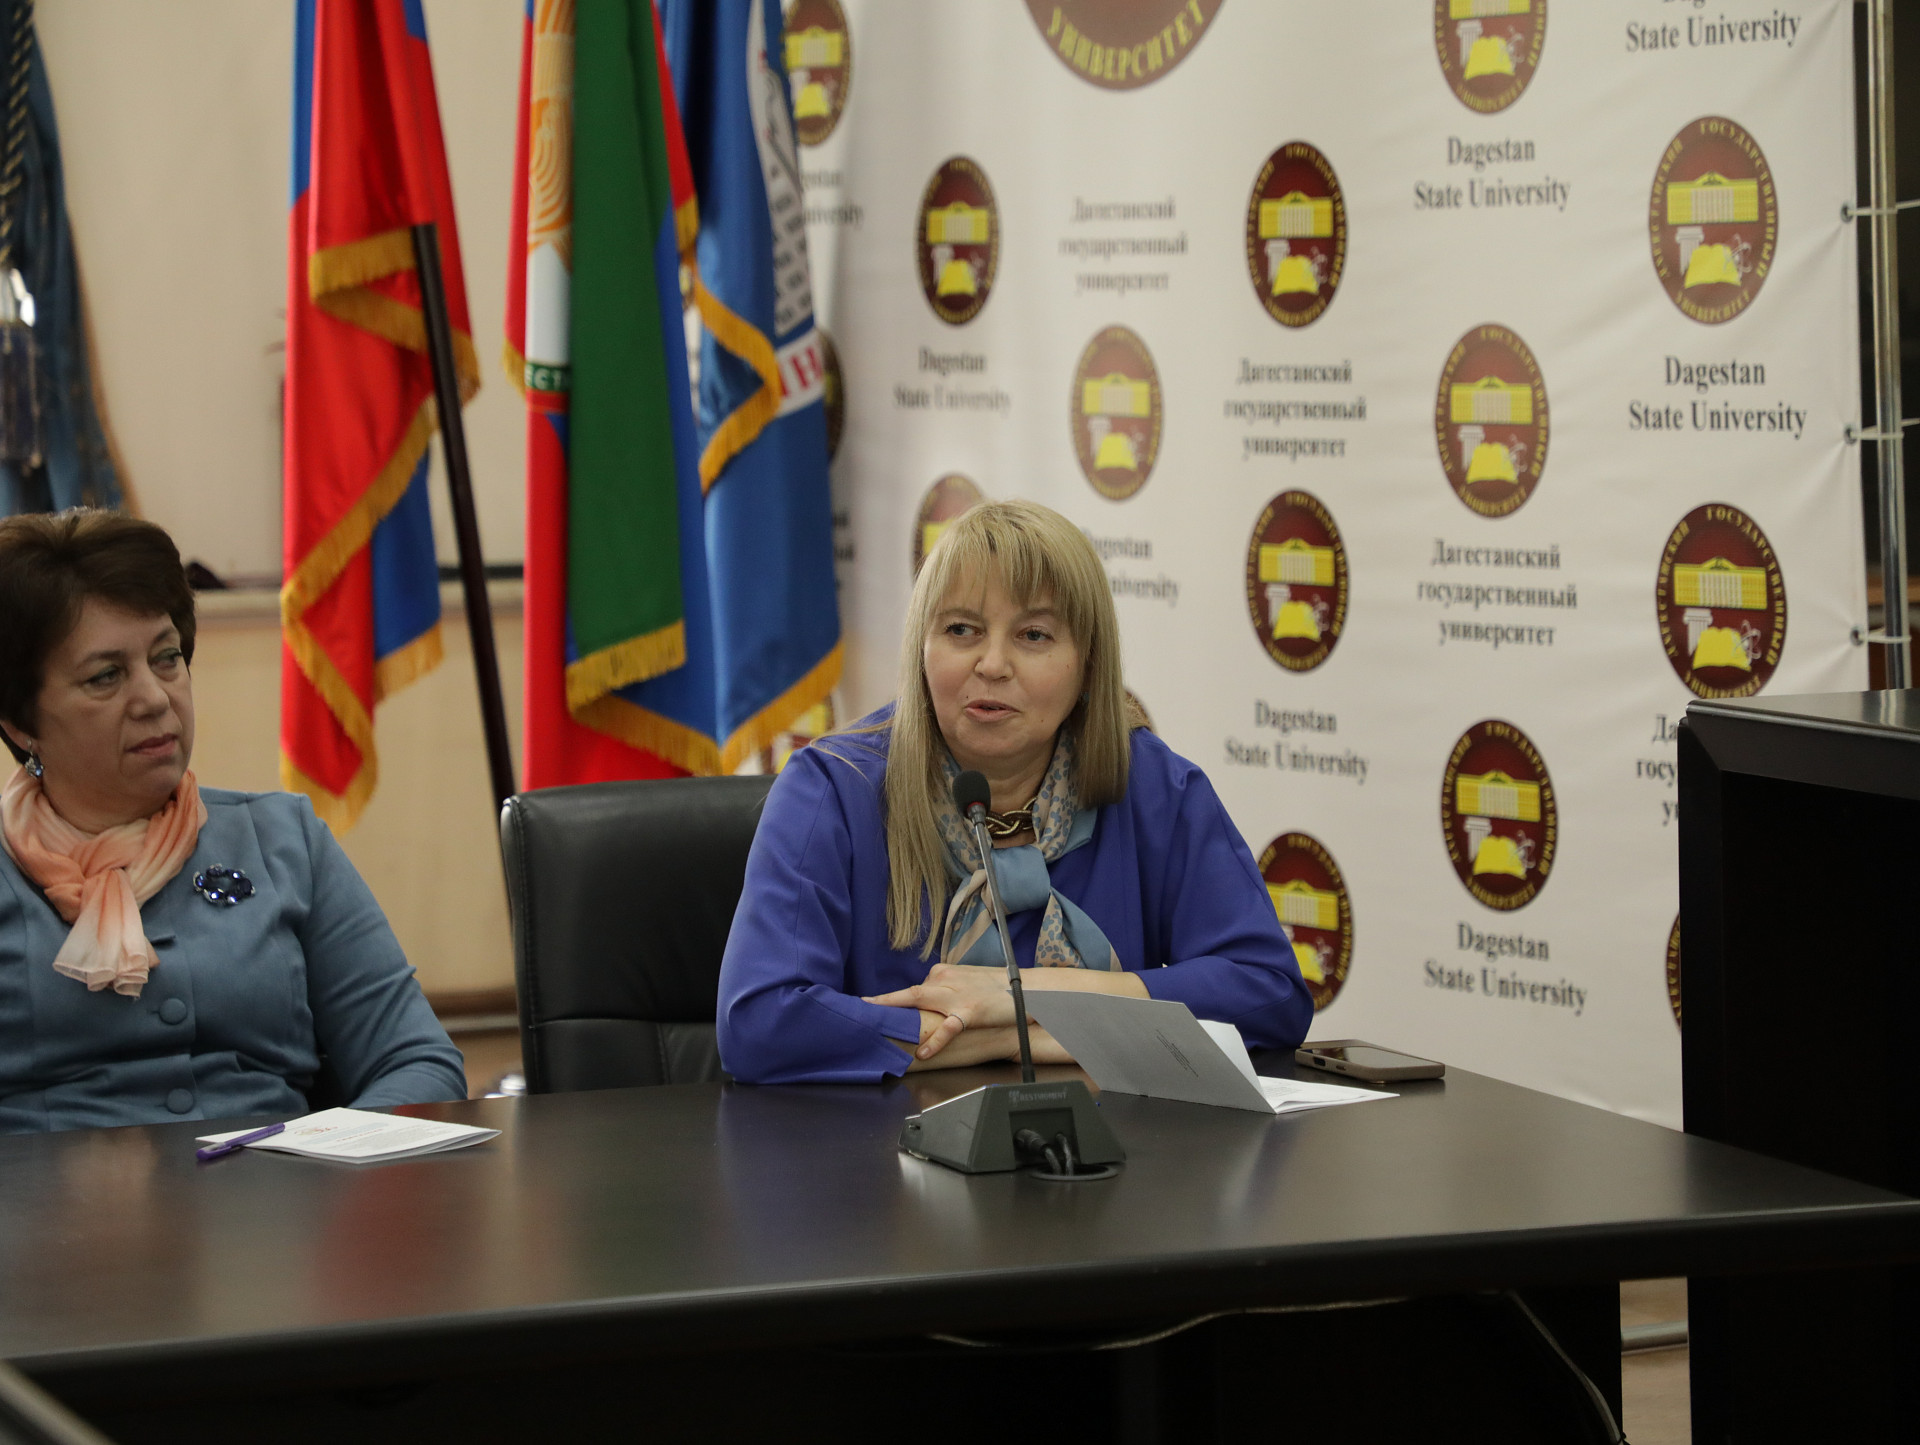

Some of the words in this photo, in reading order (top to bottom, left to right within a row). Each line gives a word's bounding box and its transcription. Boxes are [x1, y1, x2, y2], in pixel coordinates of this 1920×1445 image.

[1047, 0, 1203, 80] УНИВЕРСИТЕТ
[1626, 20, 1679, 51] State
[1687, 9, 1801, 48] University
[1447, 136, 1535, 171] Dagestan
[1414, 180, 1462, 209] State
[1469, 174, 1571, 212] University
[1236, 357, 1352, 385] Дагестанский
[1665, 355, 1766, 394] Dagestan
[1224, 396, 1367, 425] государственный
[1629, 400, 1683, 431] State
[1691, 400, 1807, 440] University
[1242, 436, 1346, 462] университет
[1431, 538, 1560, 569] Дагестанский
[1417, 581, 1577, 611] государственный
[1439, 620, 1556, 650] университет
[1255, 699, 1337, 737] Dagestan
[1225, 737, 1270, 768] State
[1274, 741, 1370, 785] University
[1457, 920, 1549, 962] Dagestan
[1424, 958, 1475, 993] State
[1481, 966, 1587, 1016] University
